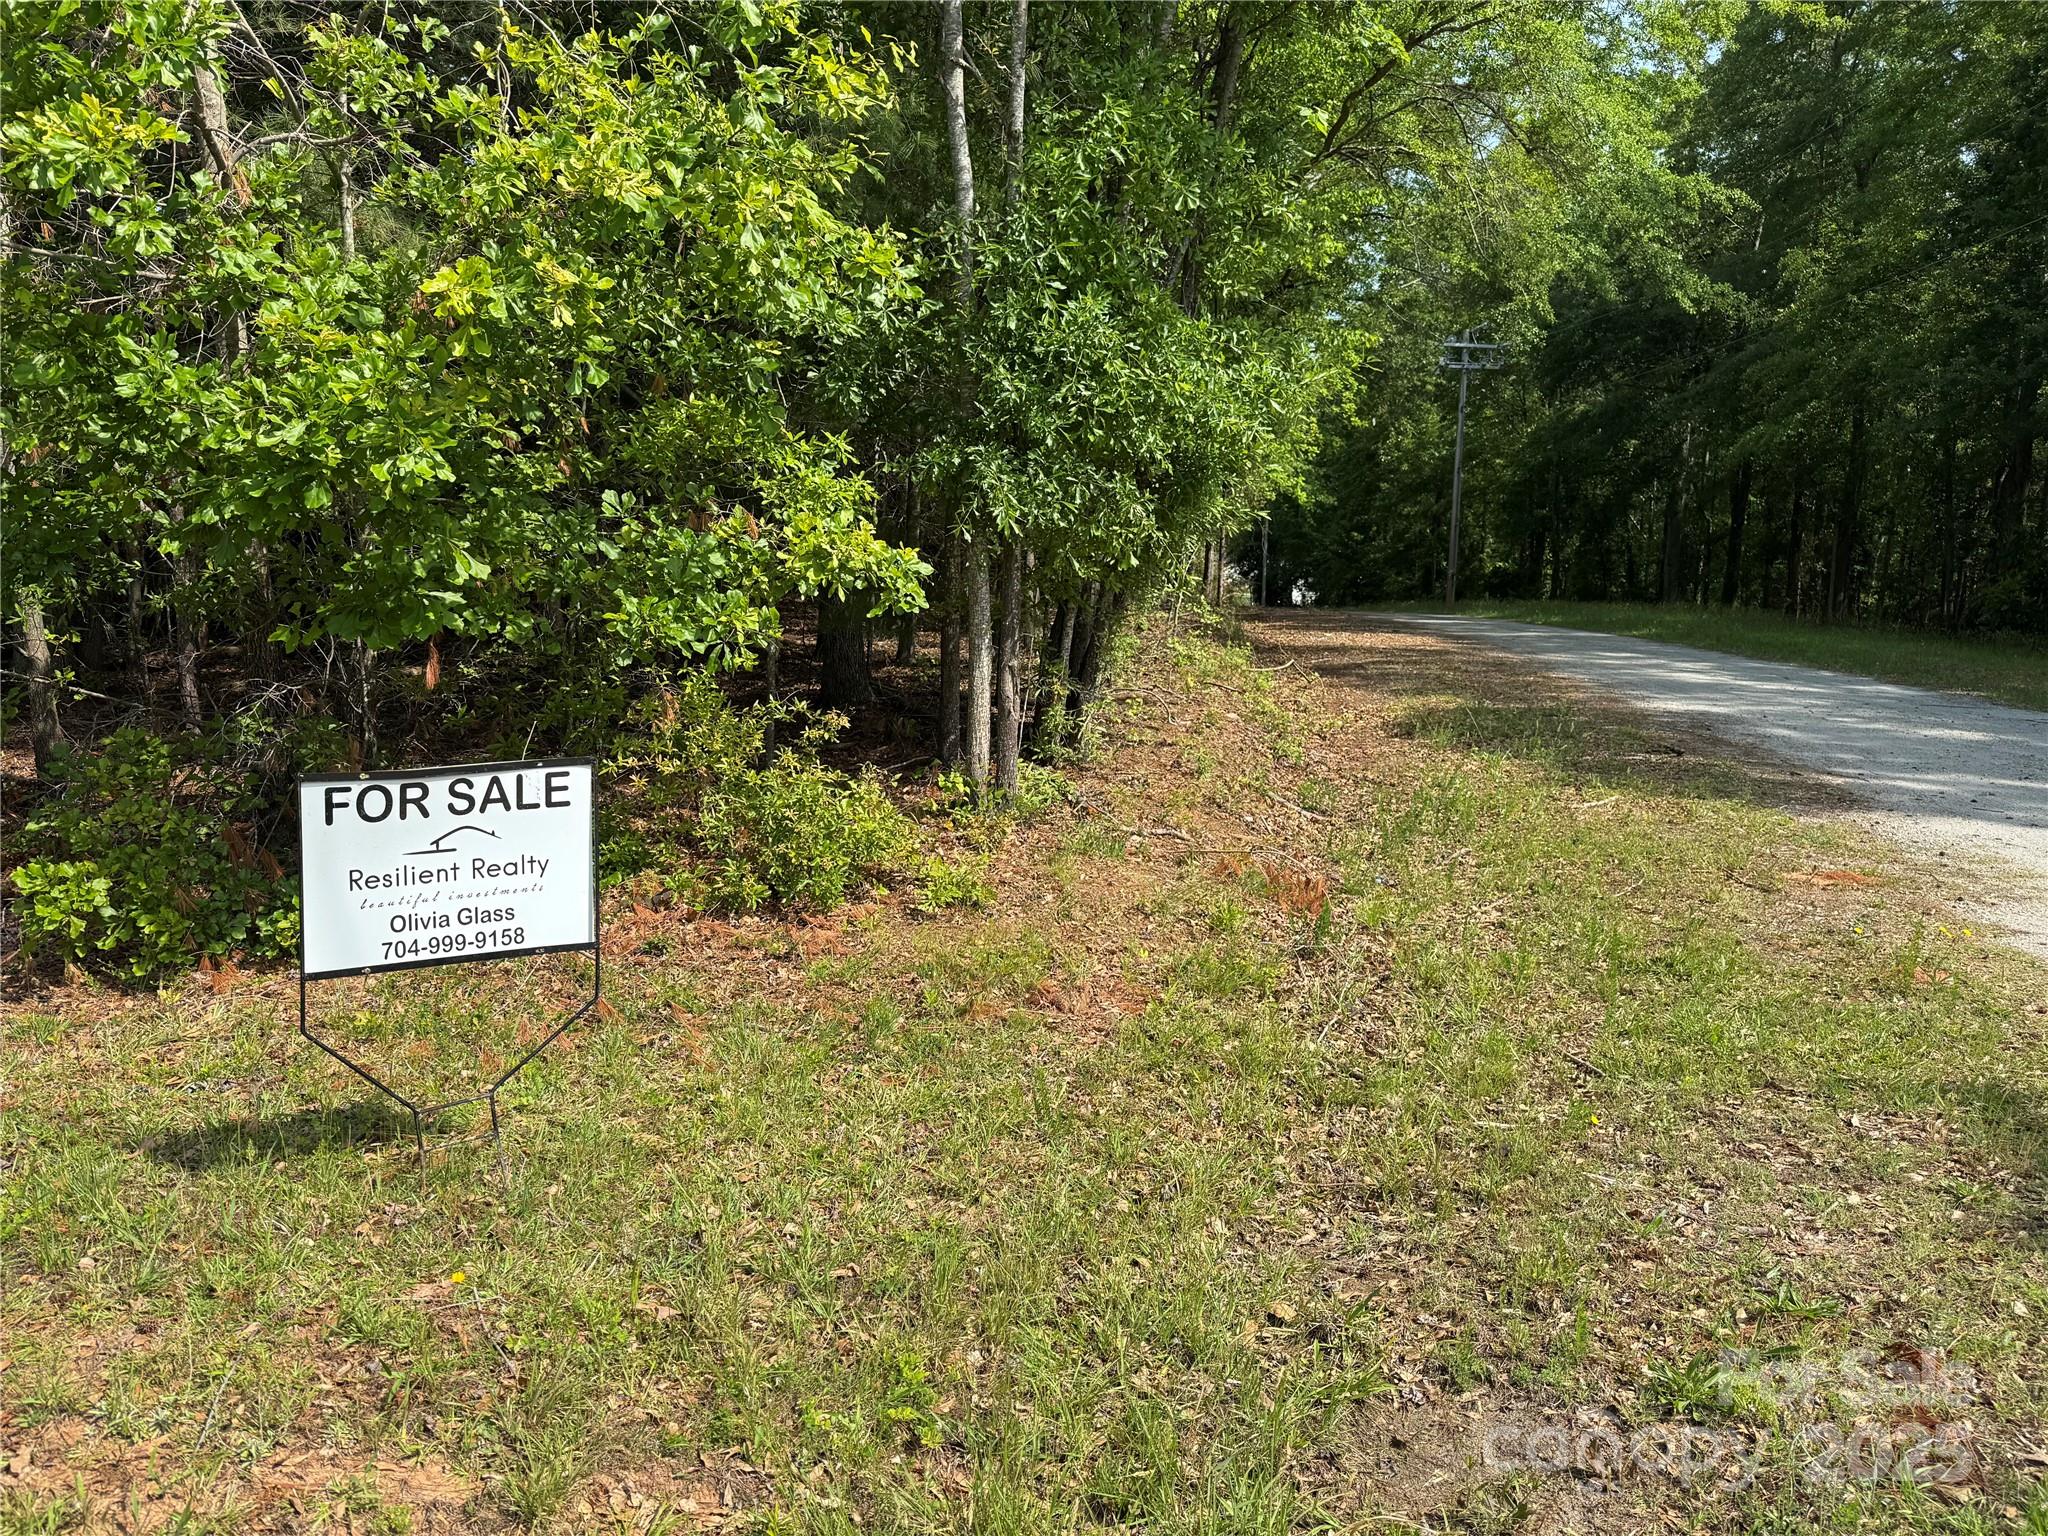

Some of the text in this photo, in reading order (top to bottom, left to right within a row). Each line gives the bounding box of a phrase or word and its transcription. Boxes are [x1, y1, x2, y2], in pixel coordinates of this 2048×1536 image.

[324, 771, 571, 826] FOR SALE
[349, 854, 549, 891] Resilient Realty
[360, 884, 544, 910] beautiful investments
[390, 907, 515, 933] Olivia Glass
[382, 927, 525, 960] 704-999-9158
